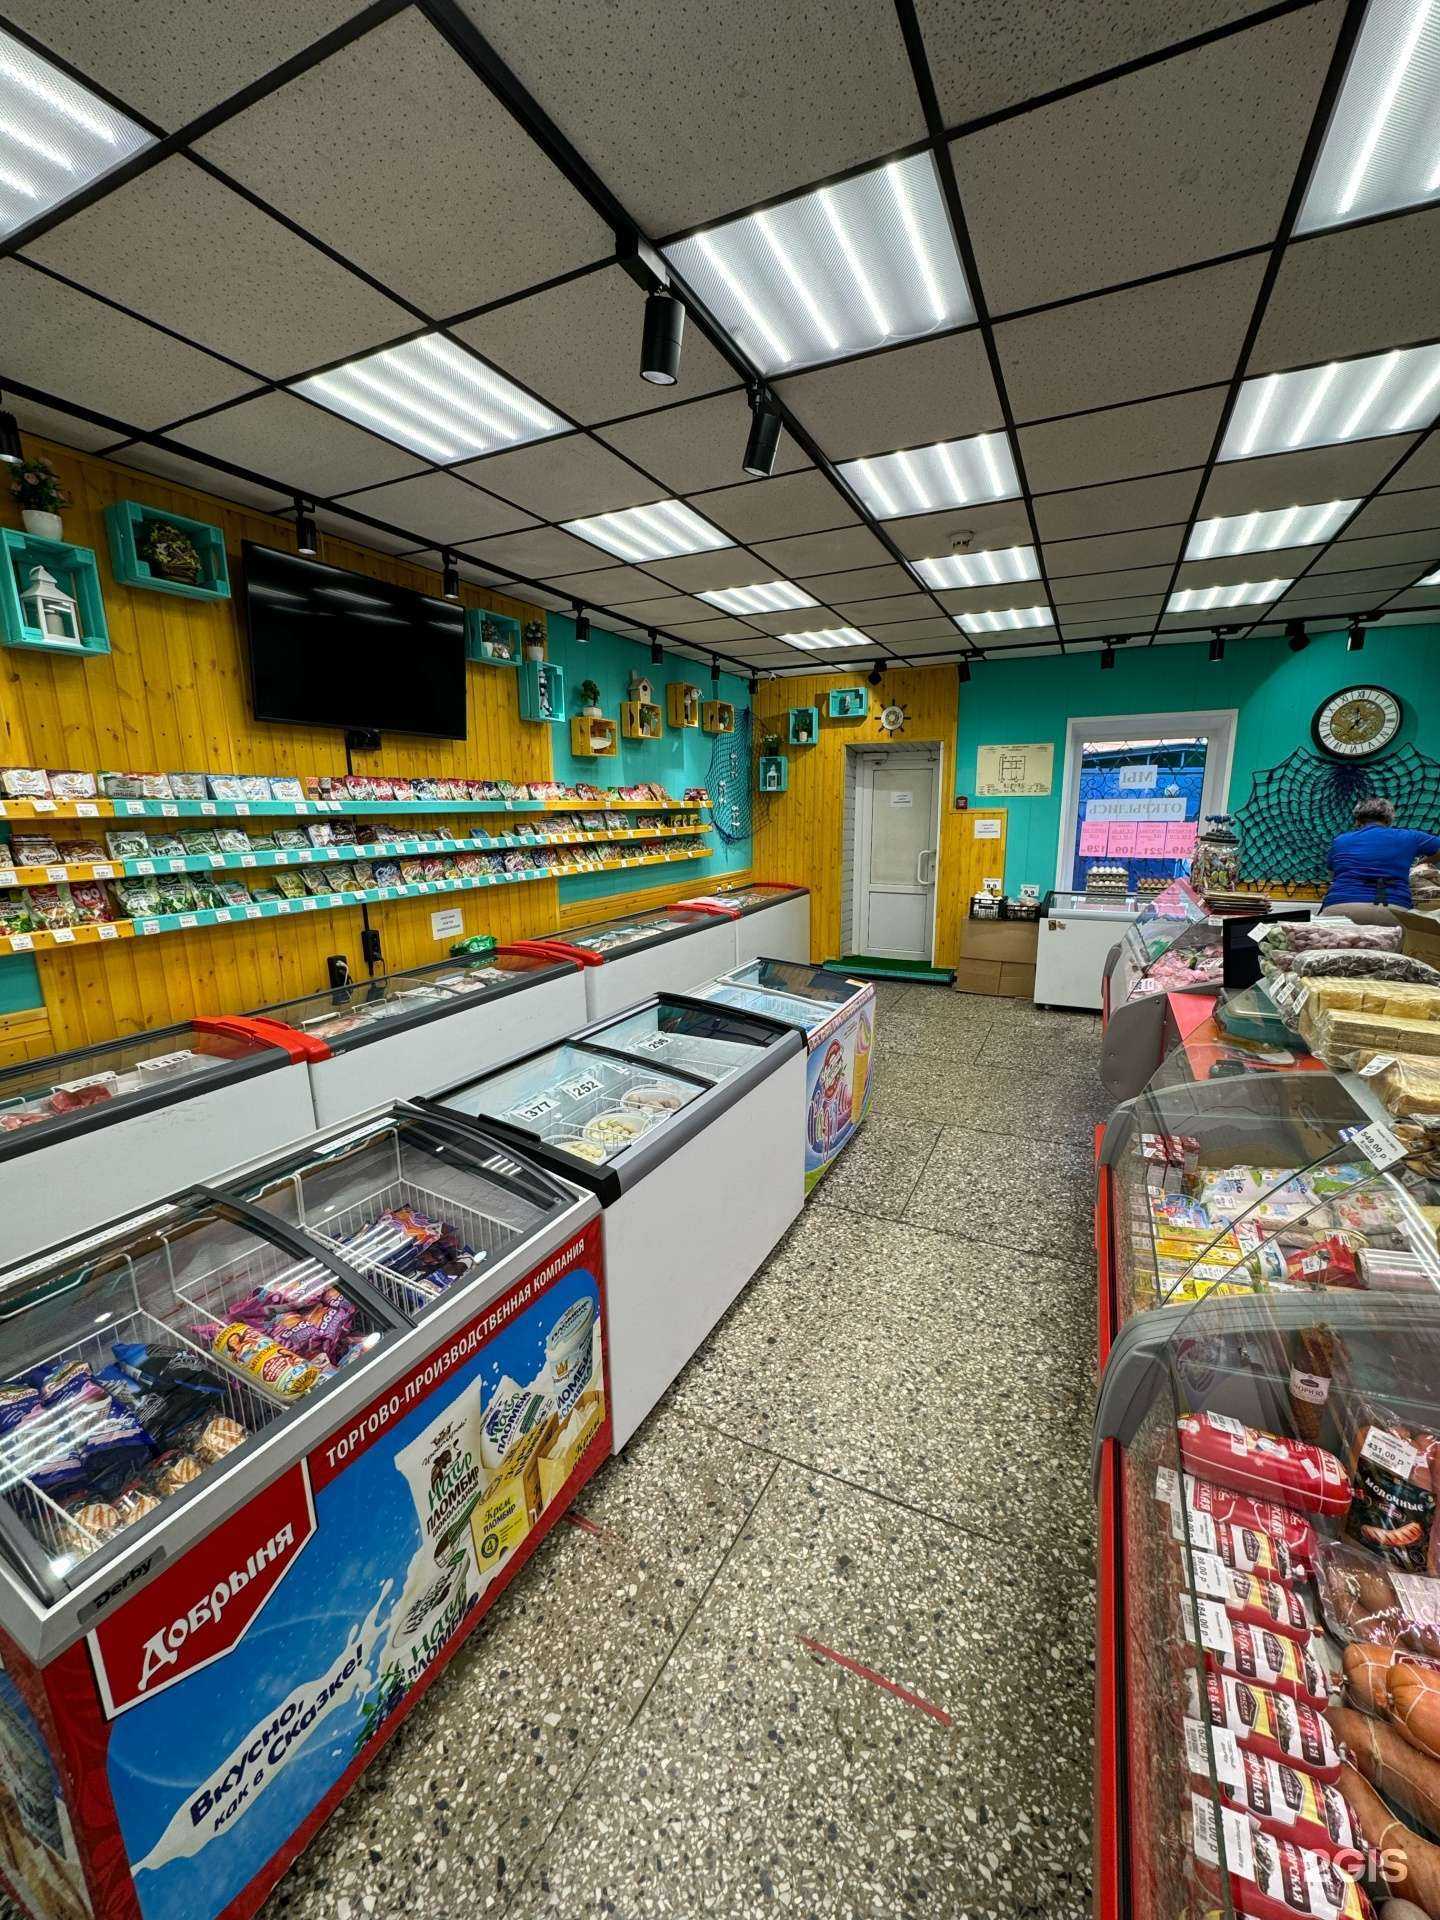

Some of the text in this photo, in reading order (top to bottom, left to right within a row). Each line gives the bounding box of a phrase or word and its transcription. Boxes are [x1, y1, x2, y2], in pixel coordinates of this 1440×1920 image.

[525, 1101, 552, 1118] 377
[573, 1080, 599, 1098] 252
[1361, 1131, 1383, 1153] 549.00
[325, 1283, 532, 1468] ТОРГОВО-ПРОИЗВОДСТВЕННАЯ
[533, 1237, 585, 1292] КОМПАНИЯ
[1367, 1442, 1396, 1461] 431.00
[426, 1466, 480, 1536] ПЛОМБИР
[483, 1504, 516, 1534] ПЛОМБИР
[93, 1556, 153, 1609] Derby
[213, 1643, 364, 1832] как в Сказке!
[190, 1700, 304, 1827] Вкусно,
